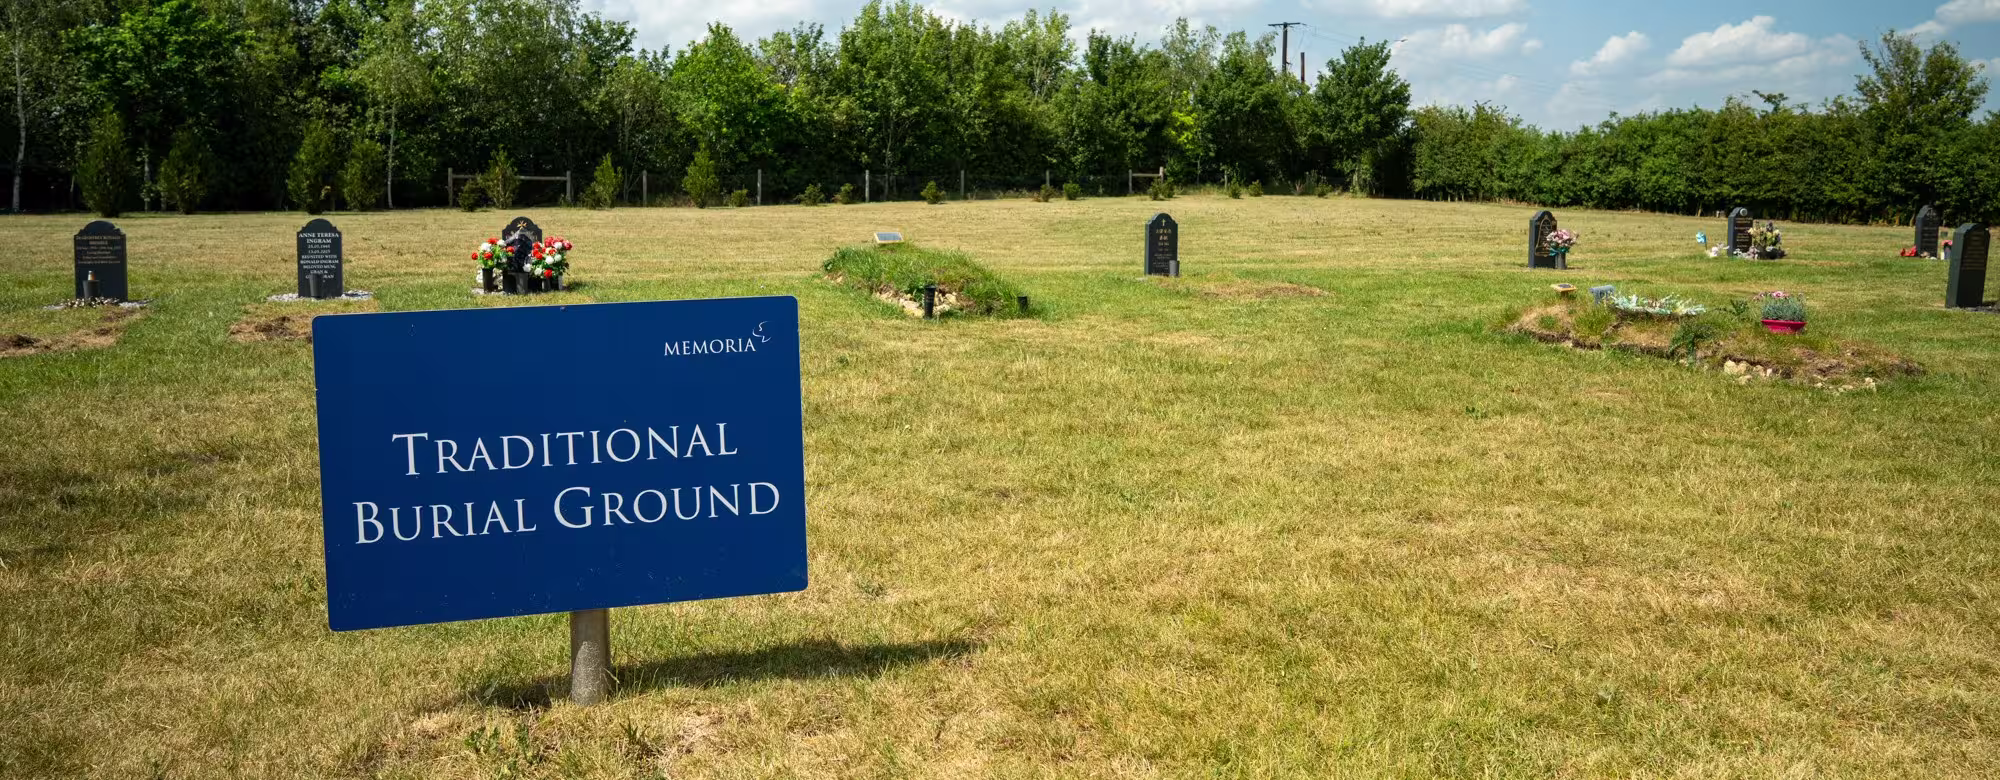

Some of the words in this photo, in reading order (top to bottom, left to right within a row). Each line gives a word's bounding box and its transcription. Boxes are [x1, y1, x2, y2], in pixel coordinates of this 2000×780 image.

[664, 337, 757, 356] MEMORIA
[392, 422, 738, 476] TRADITIONAL
[353, 499, 537, 545] BURIAL
[554, 481, 780, 529] GROUND
